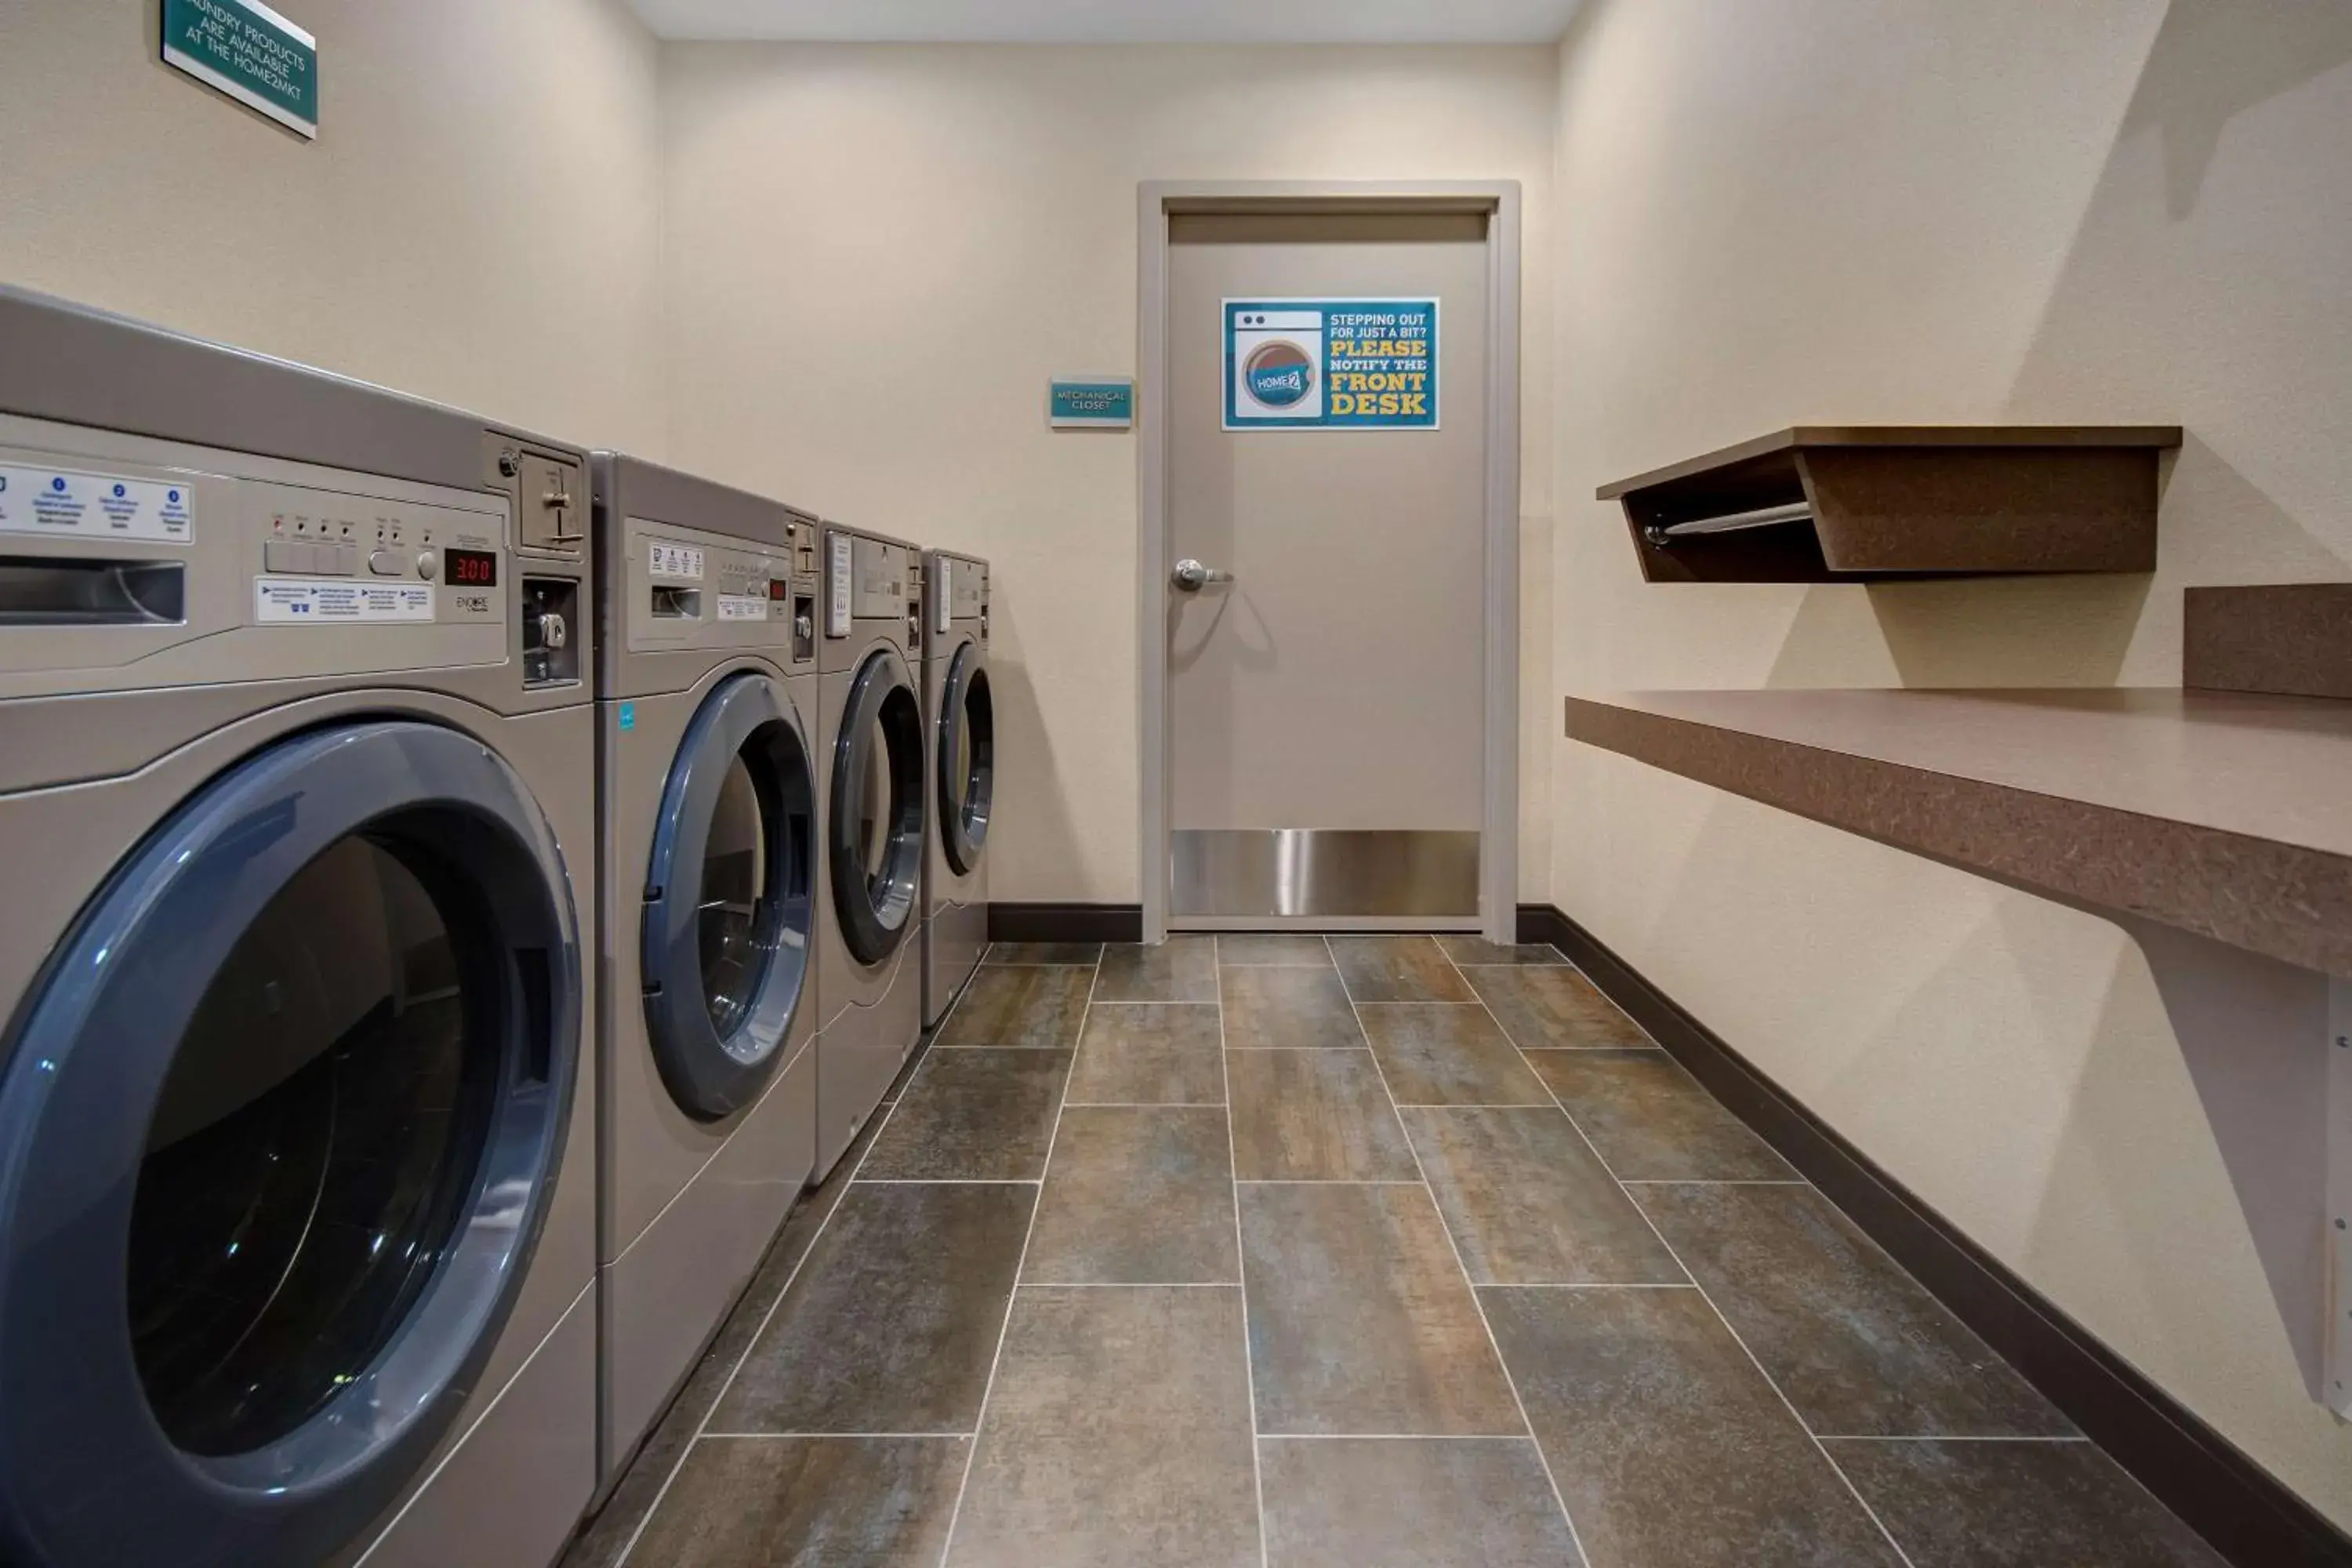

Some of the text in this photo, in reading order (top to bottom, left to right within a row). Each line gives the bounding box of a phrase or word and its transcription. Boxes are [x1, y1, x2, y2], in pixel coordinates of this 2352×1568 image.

[201, 16, 289, 79] ARE AVAILABLE
[245, 24, 305, 71] PRODUCTS
[186, 26, 301, 100] AT THE HOME2MKT
[1330, 314, 1426, 325] STEPPING OUT
[1330, 327, 1427, 338] FOR JUST A BIT?
[1330, 340, 1427, 357] PLEASE
[1330, 360, 1427, 371] NOTIFY THE
[1330, 372, 1427, 390] FRONT
[1071, 400, 1111, 410] CLOSET
[1330, 393, 1427, 415] DESK
